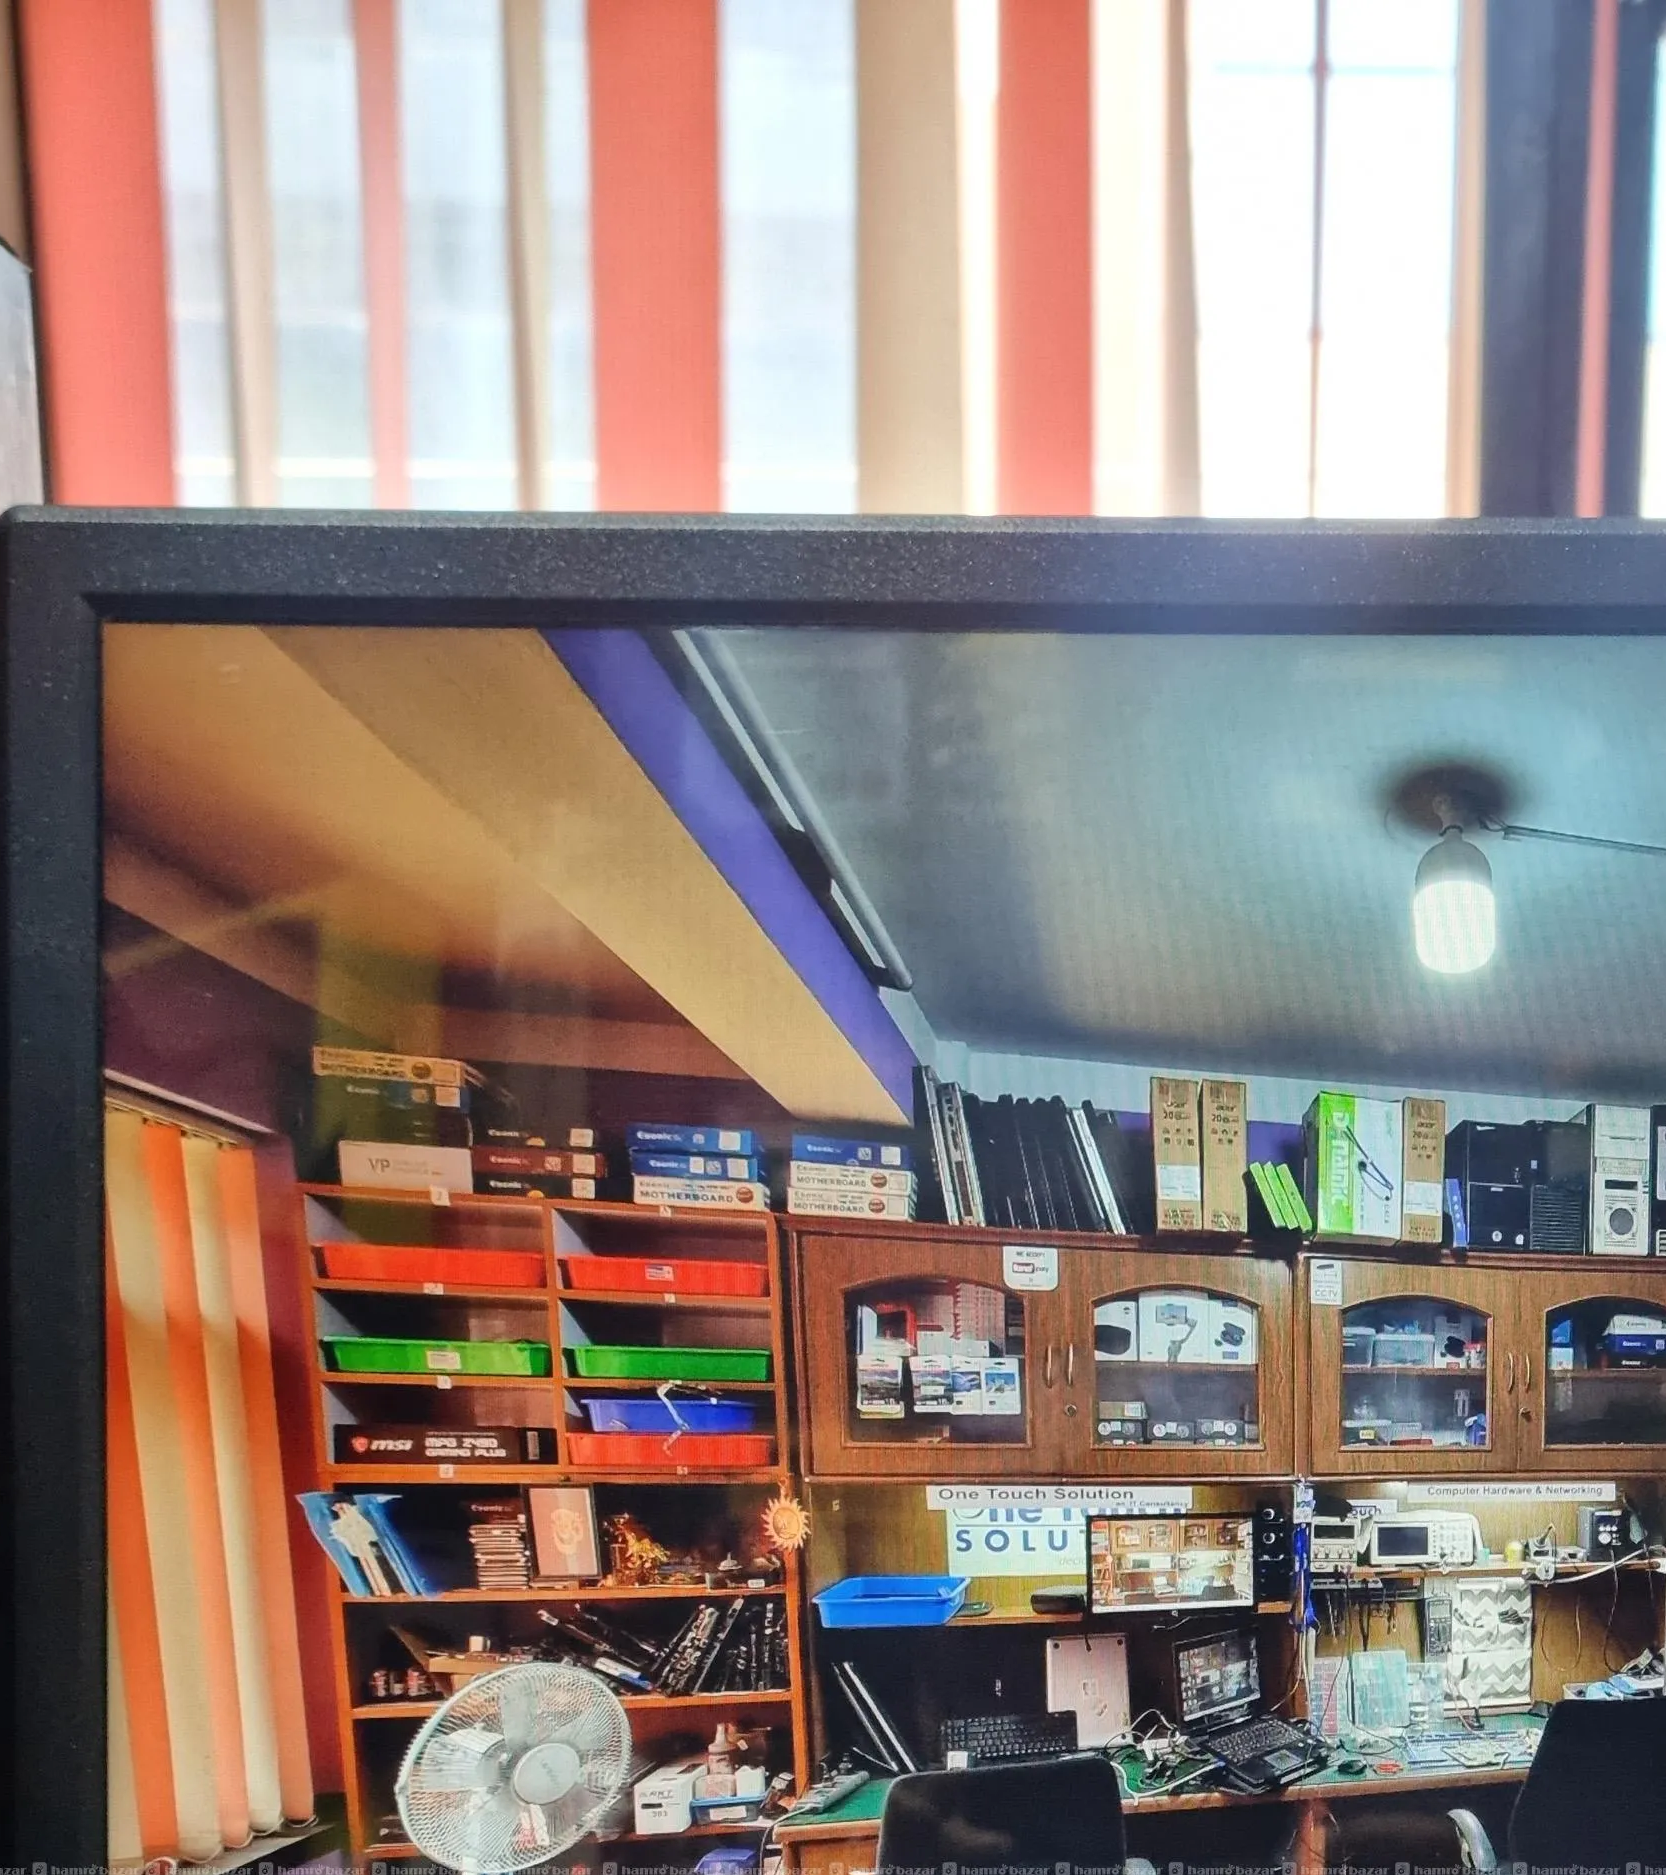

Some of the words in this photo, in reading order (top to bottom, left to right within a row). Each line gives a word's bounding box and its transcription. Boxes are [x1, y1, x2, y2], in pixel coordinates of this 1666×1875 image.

[639, 1190, 734, 1204] MOTHERBOARD
[370, 1439, 414, 1451] msi
[938, 1489, 979, 1501] One
[987, 1488, 1047, 1500] Touch
[1054, 1488, 1134, 1500] Solution
[1427, 1486, 1480, 1498] Computer
[1483, 1485, 1533, 1496] Hardware
[1535, 1485, 1543, 1495] &
[1545, 1484, 1604, 1496] Networking
